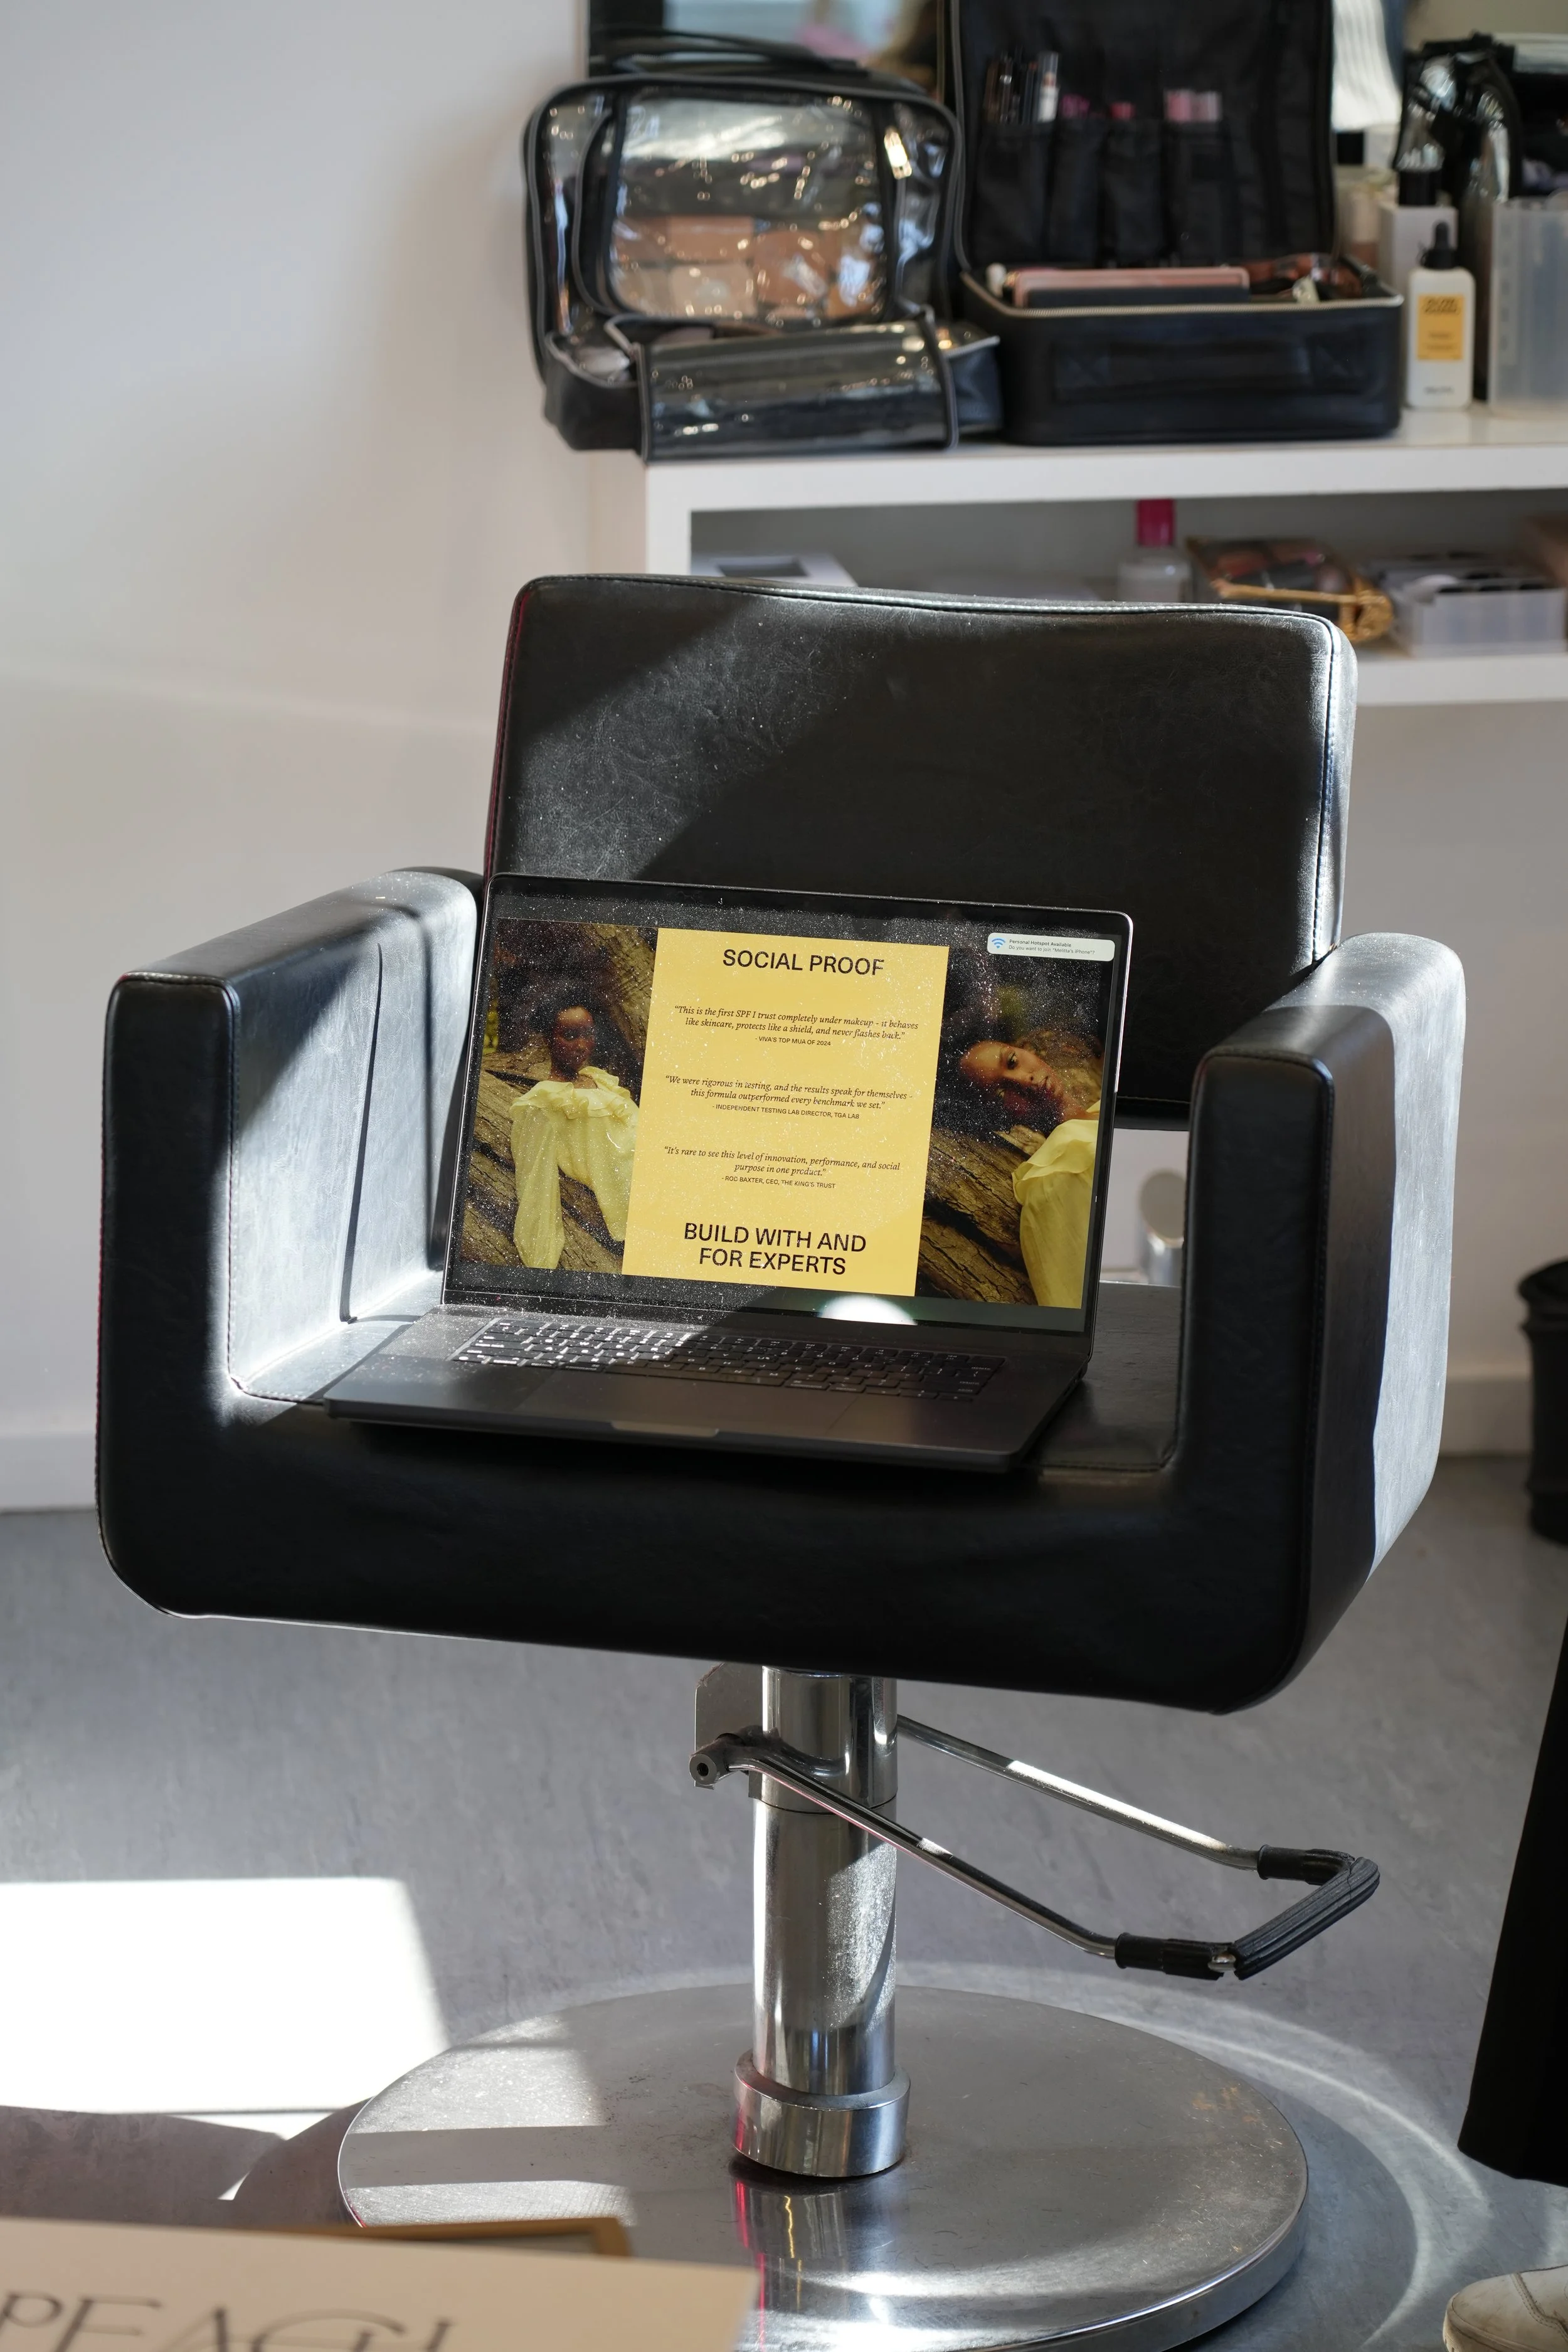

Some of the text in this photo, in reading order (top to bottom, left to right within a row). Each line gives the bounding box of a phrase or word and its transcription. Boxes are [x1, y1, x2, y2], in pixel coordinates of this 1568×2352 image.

[723, 949, 885, 976] SOCIAL PROOF
[674, 1005, 695, 1014] “This
[696, 1007, 703, 1015] is
[704, 1007, 717, 1015] the
[716, 1008, 734, 1018] first
[735, 1010, 751, 1018] SPF
[778, 1014, 818, 1024] completely
[819, 1015, 842, 1024] under
[843, 1017, 874, 1028] makeup
[889, 1019, 919, 1030] behaves
[685, 1017, 699, 1026] like
[700, 1019, 734, 1029] skincare,
[768, 1022, 781, 1032] like
[789, 1024, 813, 1035] shield,
[815, 1027, 831, 1035] and
[852, 1029, 881, 1039] flashes
[665, 1075, 681, 1084] “We
[702, 1078, 733, 1088] rigorous
[735, 1079, 743, 1088] in
[744, 1081, 772, 1092] testing,
[774, 1083, 790, 1091] and
[790, 1084, 803, 1092] the
[804, 1086, 830, 1094] results
[830, 1088, 852, 1097] speak
[852, 1088, 866, 1098] for
[867, 1089, 908, 1099] themselves
[691, 1088, 705, 1097] this
[704, 1089, 737, 1099] formula
[738, 1093, 790, 1103] outperformed
[791, 1097, 812, 1106] every
[813, 1096, 855, 1107] benchmark
[716, 1104, 760, 1112] INDEPENDENT
[801, 1110, 833, 1118] DIRECTOR,
[664, 1145, 679, 1155] “It’s
[721, 1150, 736, 1159] this
[736, 1151, 755, 1160] level
[755, 1152, 765, 1162] of
[765, 1153, 808, 1165] innovation,
[808, 1157, 860, 1169] performance,
[877, 1162, 901, 1170] social
[733, 1164, 765, 1173] purpose
[766, 1164, 775, 1172] in
[790, 1167, 827, 1176] product.”
[684, 1222, 867, 1253] BUILD WITH AND
[699, 1247, 846, 1275] FOR EXPERTS
